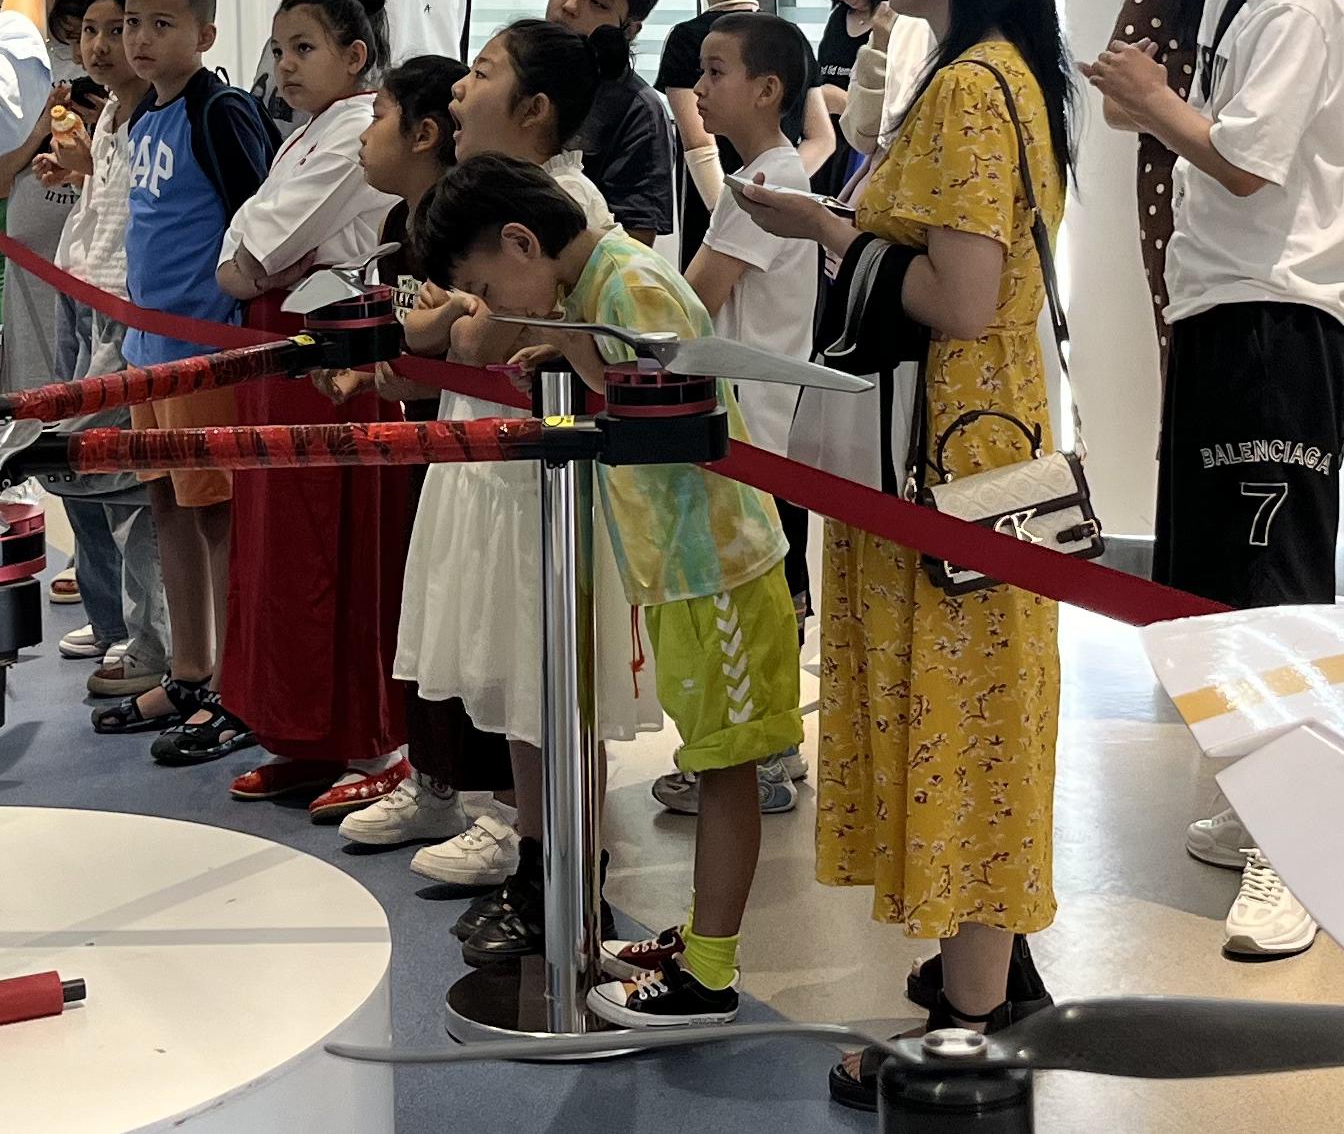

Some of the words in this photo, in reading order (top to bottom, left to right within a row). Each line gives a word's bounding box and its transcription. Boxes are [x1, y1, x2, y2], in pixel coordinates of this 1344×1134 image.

[127, 133, 174, 199] AP
[1200, 439, 1332, 476] BALENCIAGA
[1240, 481, 1288, 547] 7
